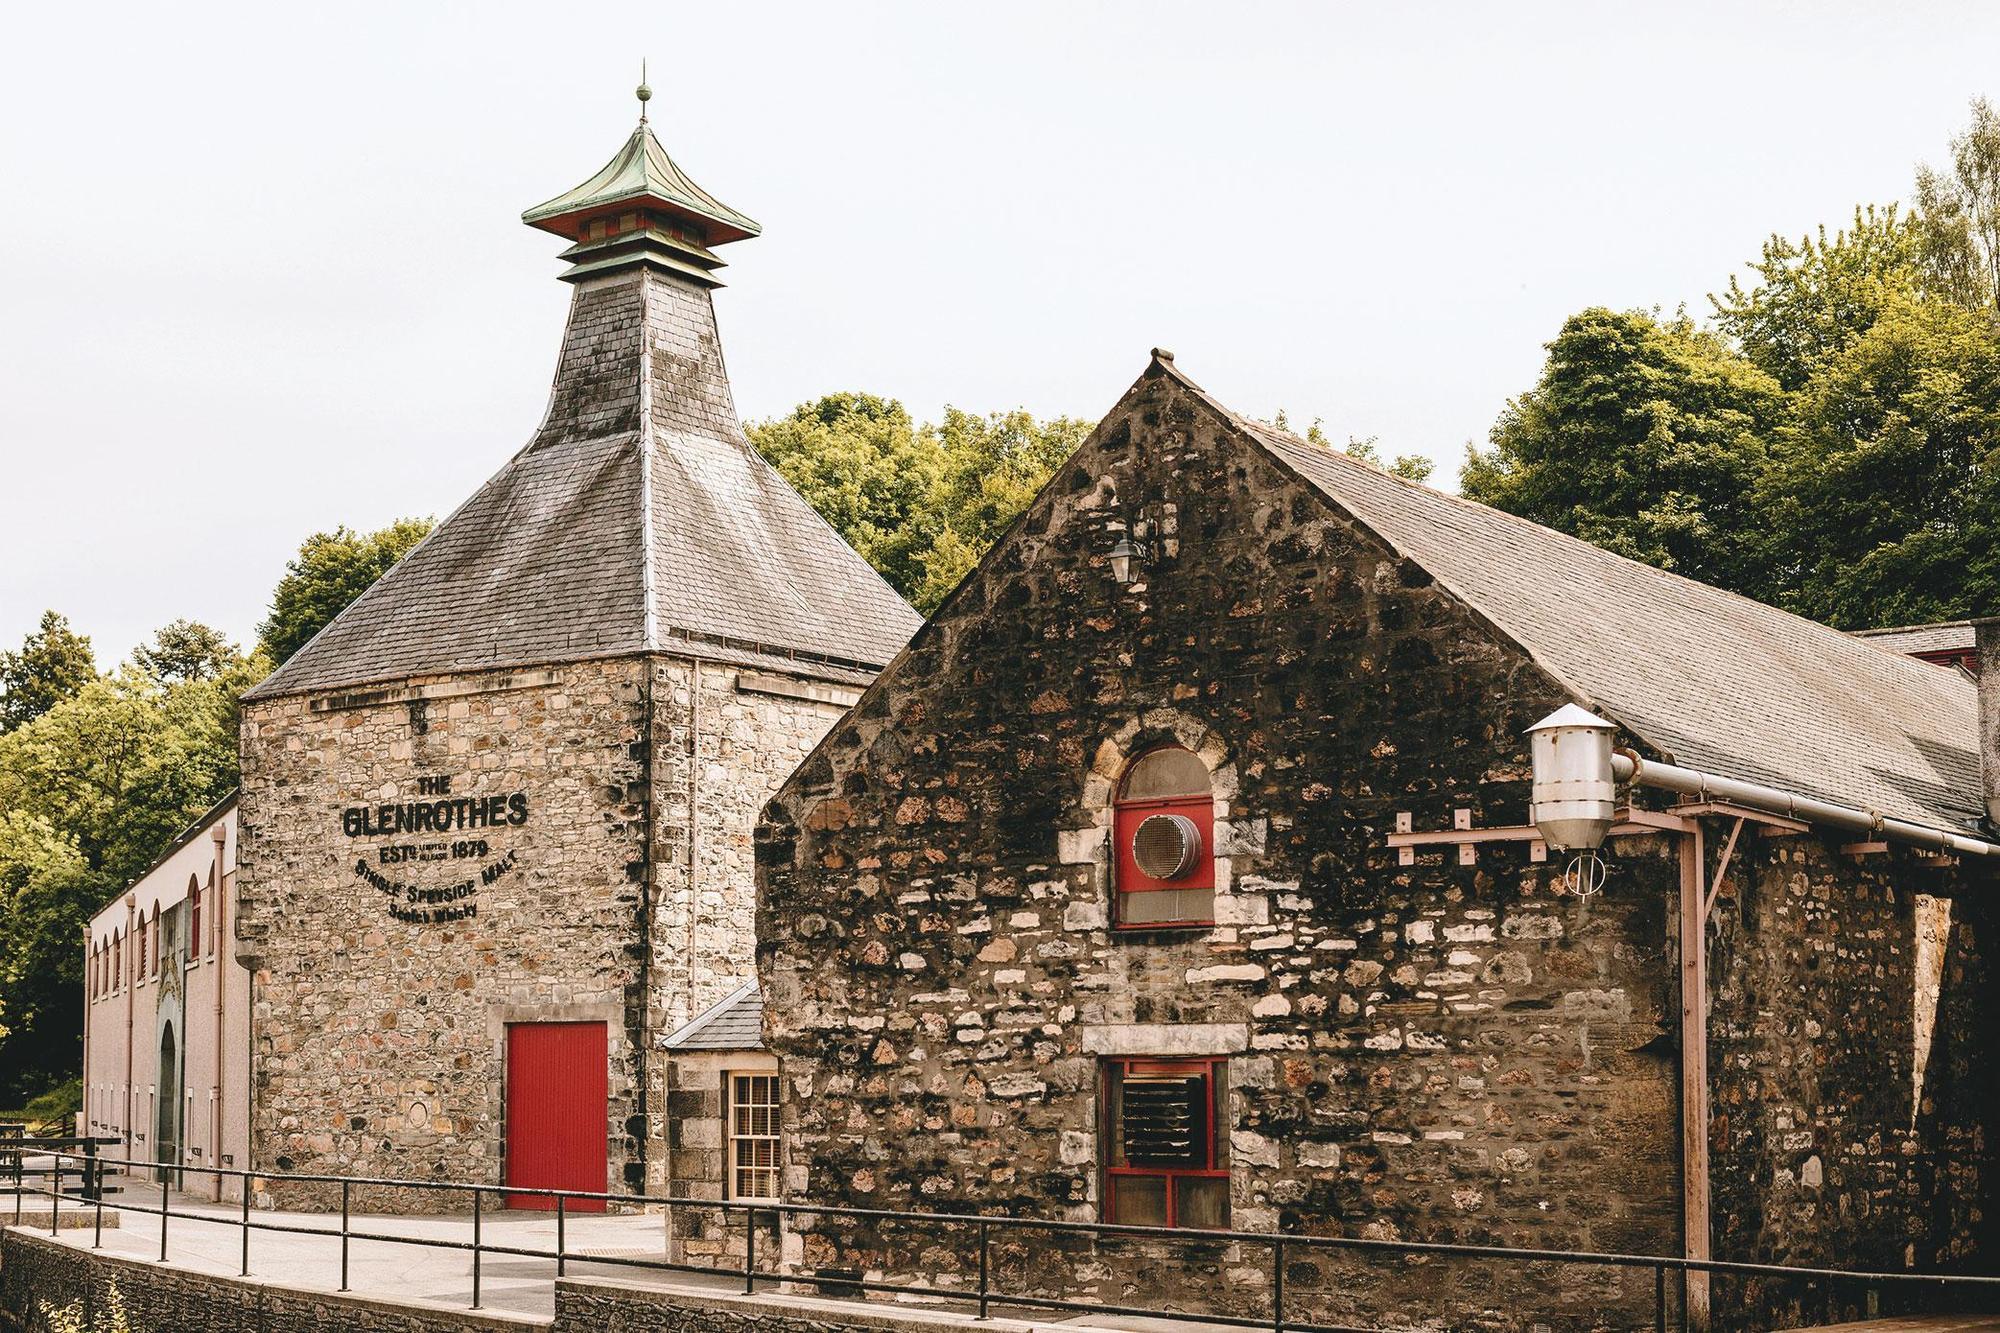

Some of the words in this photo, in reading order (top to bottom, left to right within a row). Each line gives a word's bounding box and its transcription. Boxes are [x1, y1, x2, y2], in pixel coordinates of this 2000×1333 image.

[417, 775, 451, 795] THE
[343, 792, 528, 837] GLENROTHES
[451, 840, 488, 858] 1879
[389, 903, 430, 924] Scotch
[434, 903, 477, 923] Whisky
